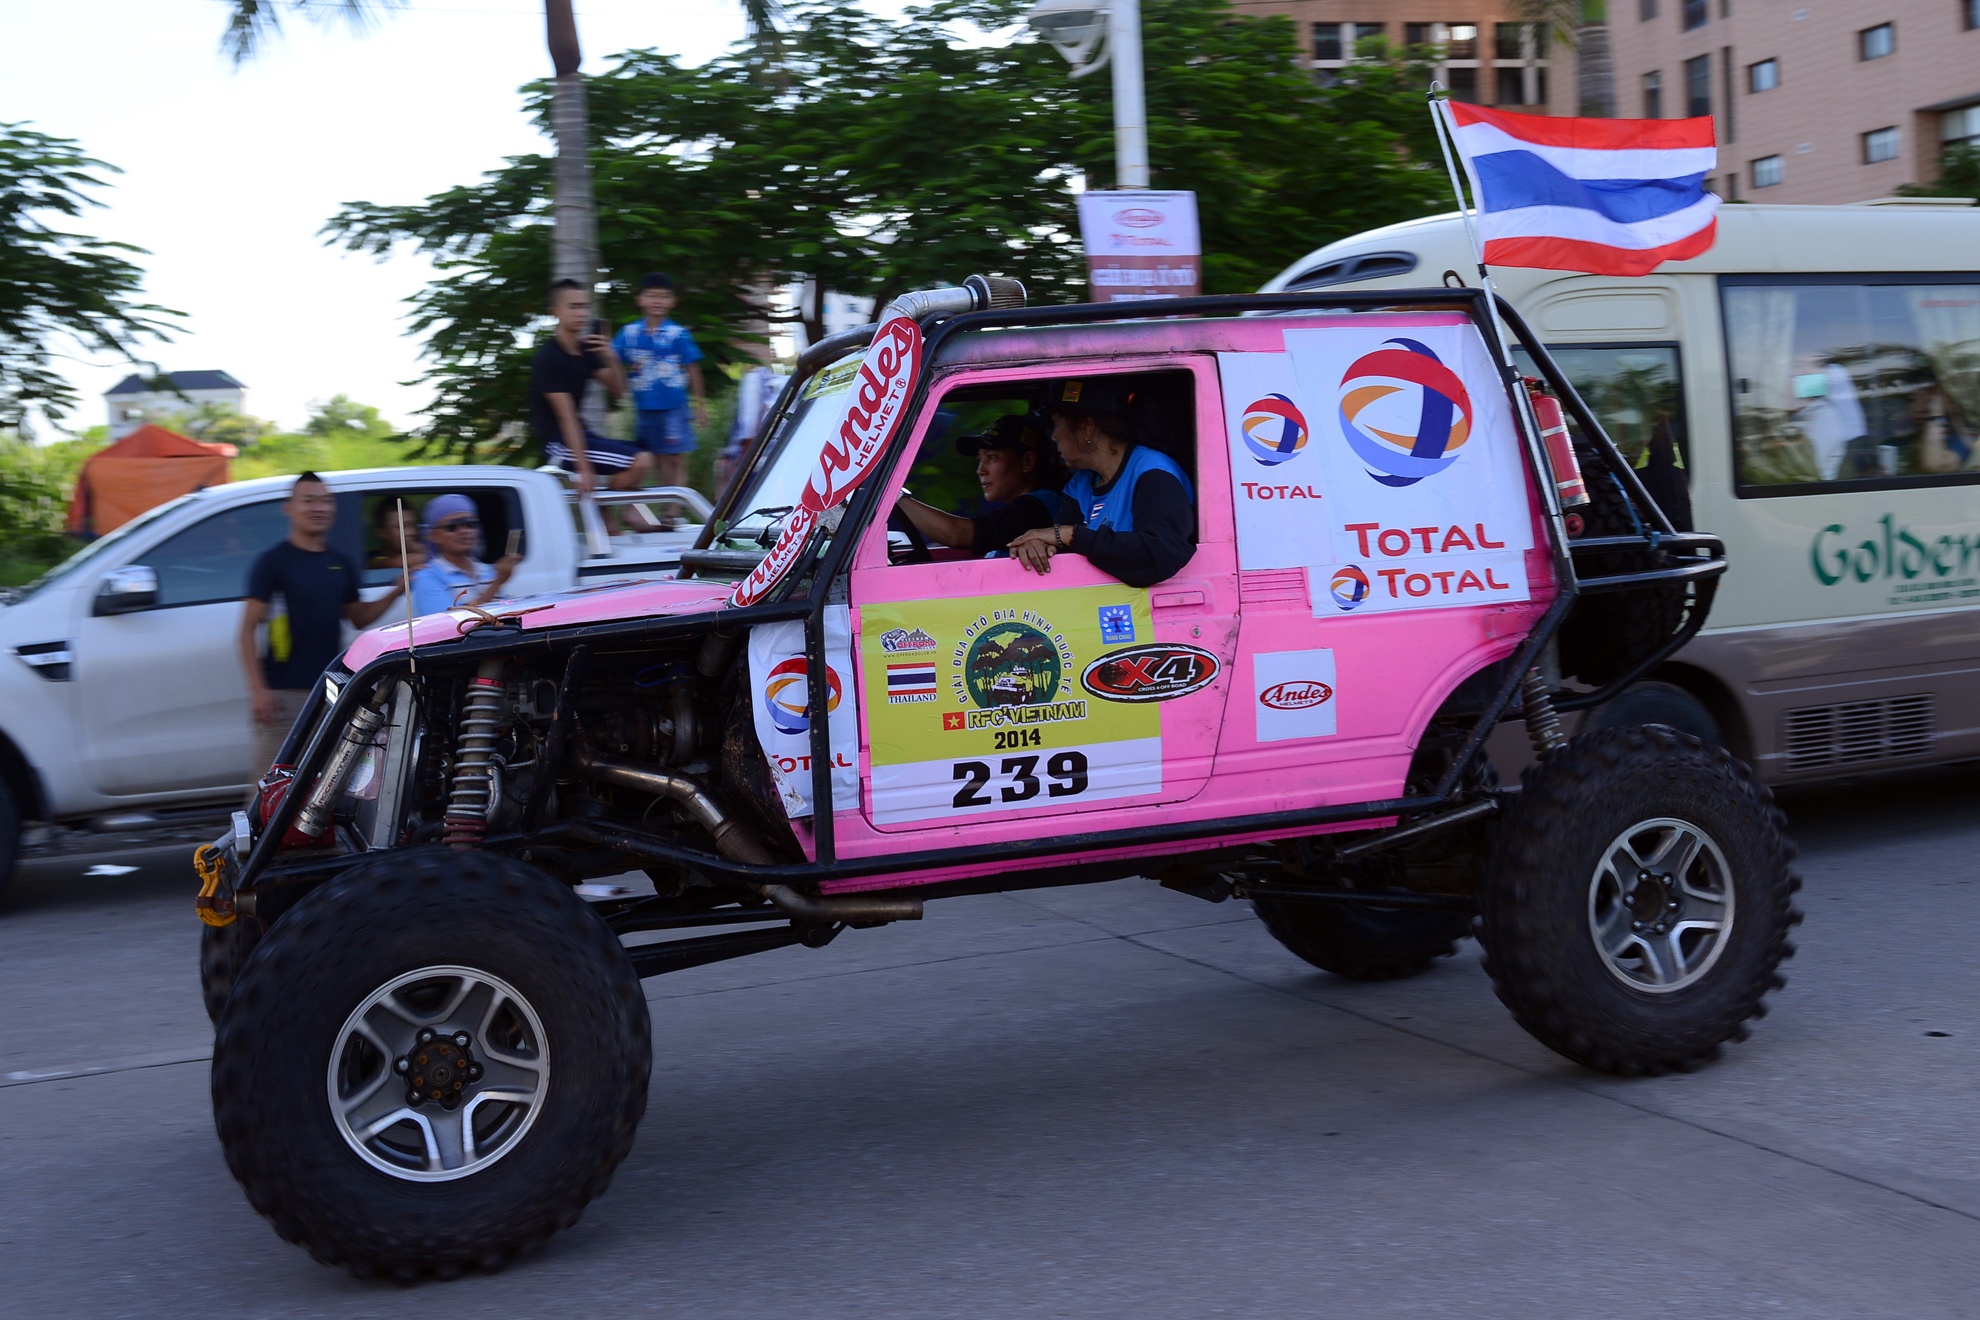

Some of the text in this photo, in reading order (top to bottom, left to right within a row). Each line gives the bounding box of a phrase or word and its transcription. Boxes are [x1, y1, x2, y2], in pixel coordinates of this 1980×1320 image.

[814, 323, 914, 508] Andes
[1241, 482, 1322, 500] TOTAL
[1344, 522, 1505, 559] TOTAL
[1377, 568, 1509, 598] TOTAL
[889, 693, 937, 704] THAILAND
[1264, 684, 1330, 702] Andes
[994, 728, 1041, 750] 2014
[952, 751, 1089, 808] 239
